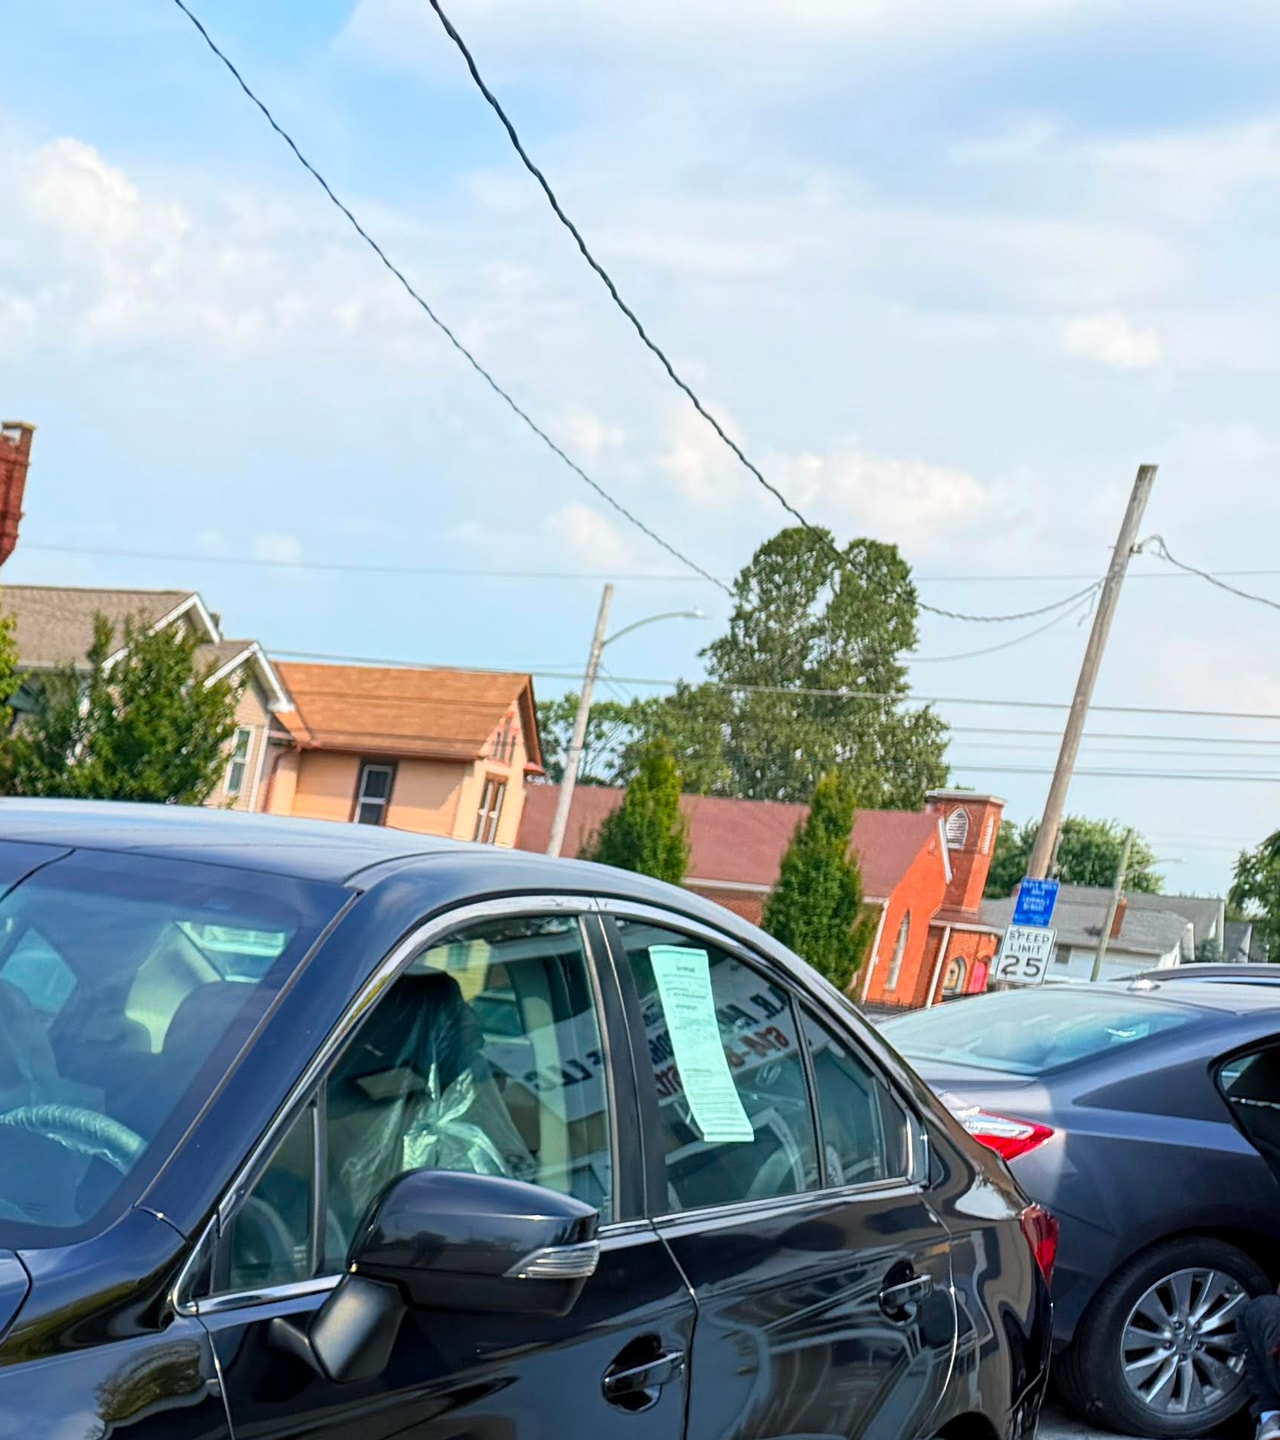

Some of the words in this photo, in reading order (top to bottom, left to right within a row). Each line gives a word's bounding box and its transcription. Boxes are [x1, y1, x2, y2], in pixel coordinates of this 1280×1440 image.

[1009, 929, 1050, 944] SPEED
[1010, 942, 1042, 955] LIMIT
[1001, 955, 1044, 978] 25
